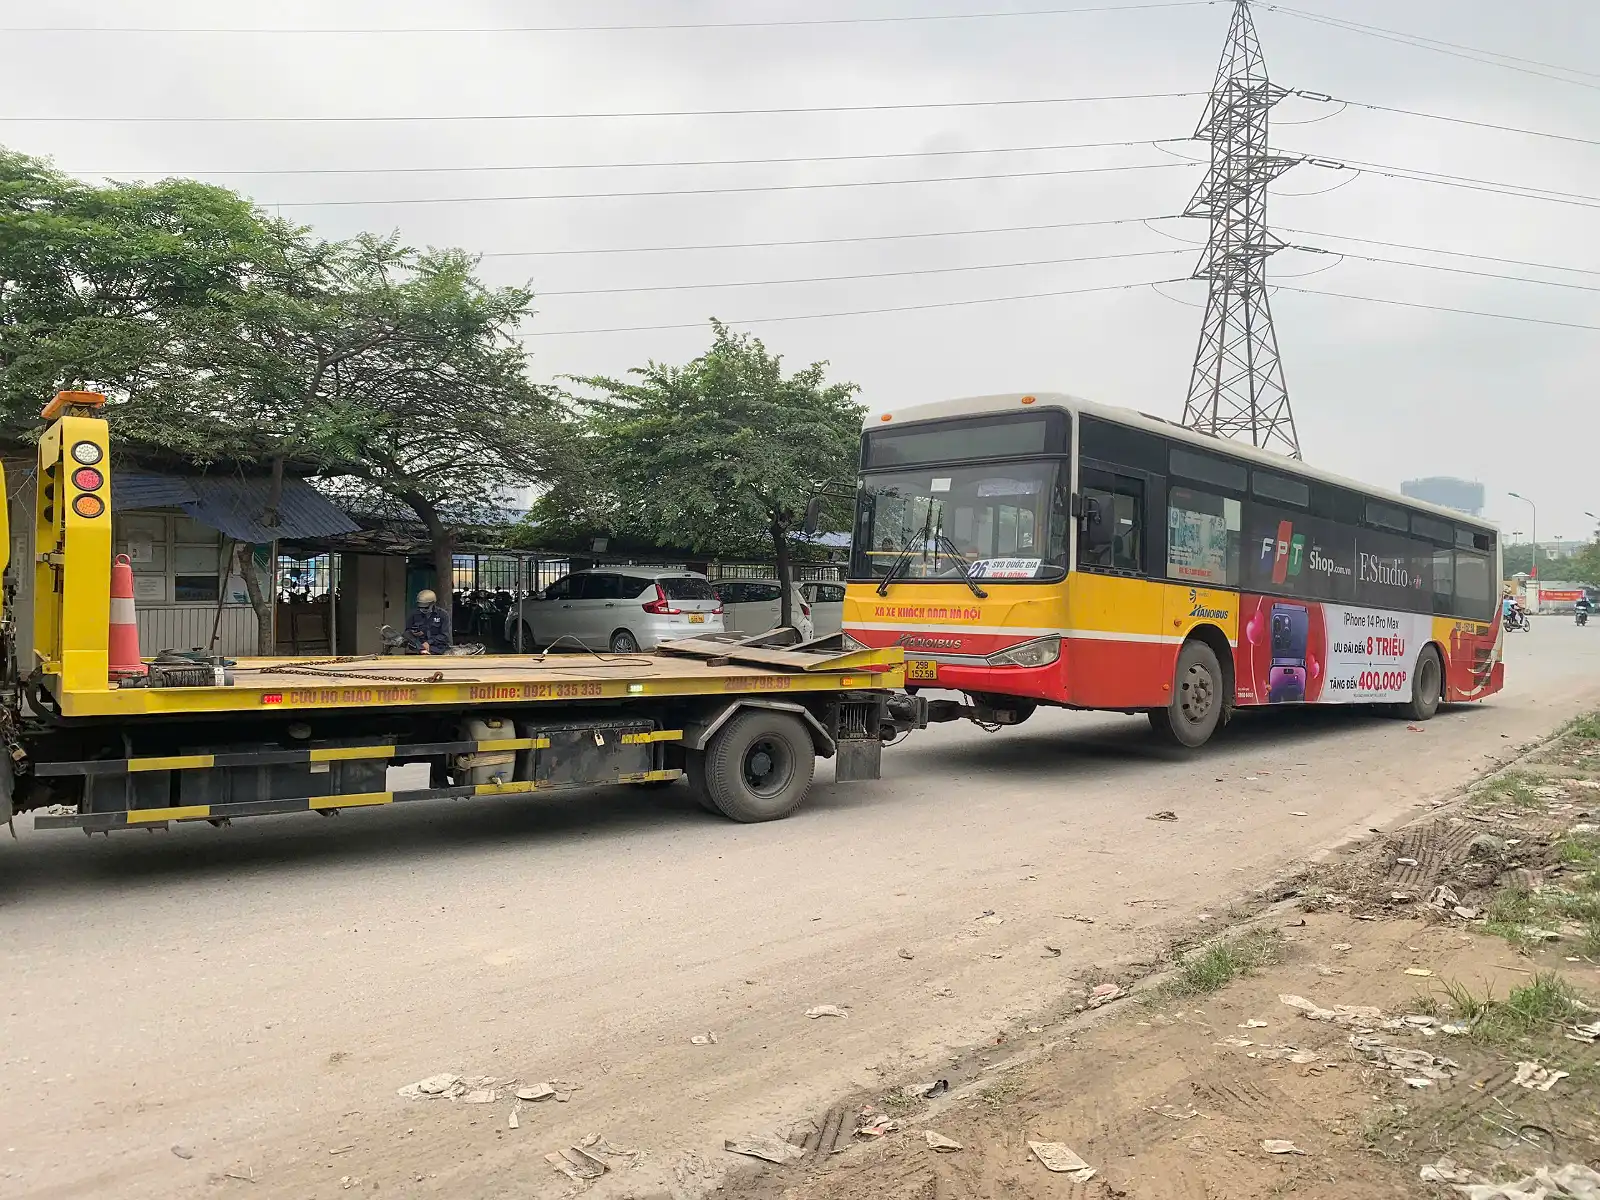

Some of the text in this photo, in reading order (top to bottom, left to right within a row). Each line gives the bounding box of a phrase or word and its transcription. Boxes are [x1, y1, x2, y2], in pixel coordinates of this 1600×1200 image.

[968, 560, 989, 578] 26
[1309, 551, 1352, 576] Shop.com.vn
[1359, 552, 1408, 587] F.Studio
[886, 607, 895, 617] XE
[1189, 604, 1228, 620] HANOIBUS
[1344, 612, 1400, 629] iPhone 14 Pro Max
[1366, 636, 1373, 655] 8
[1375, 633, 1405, 661] TRIỆU
[343, 689, 372, 703] GIAO
[469, 683, 602, 699] Hotline: 0921 335 335
